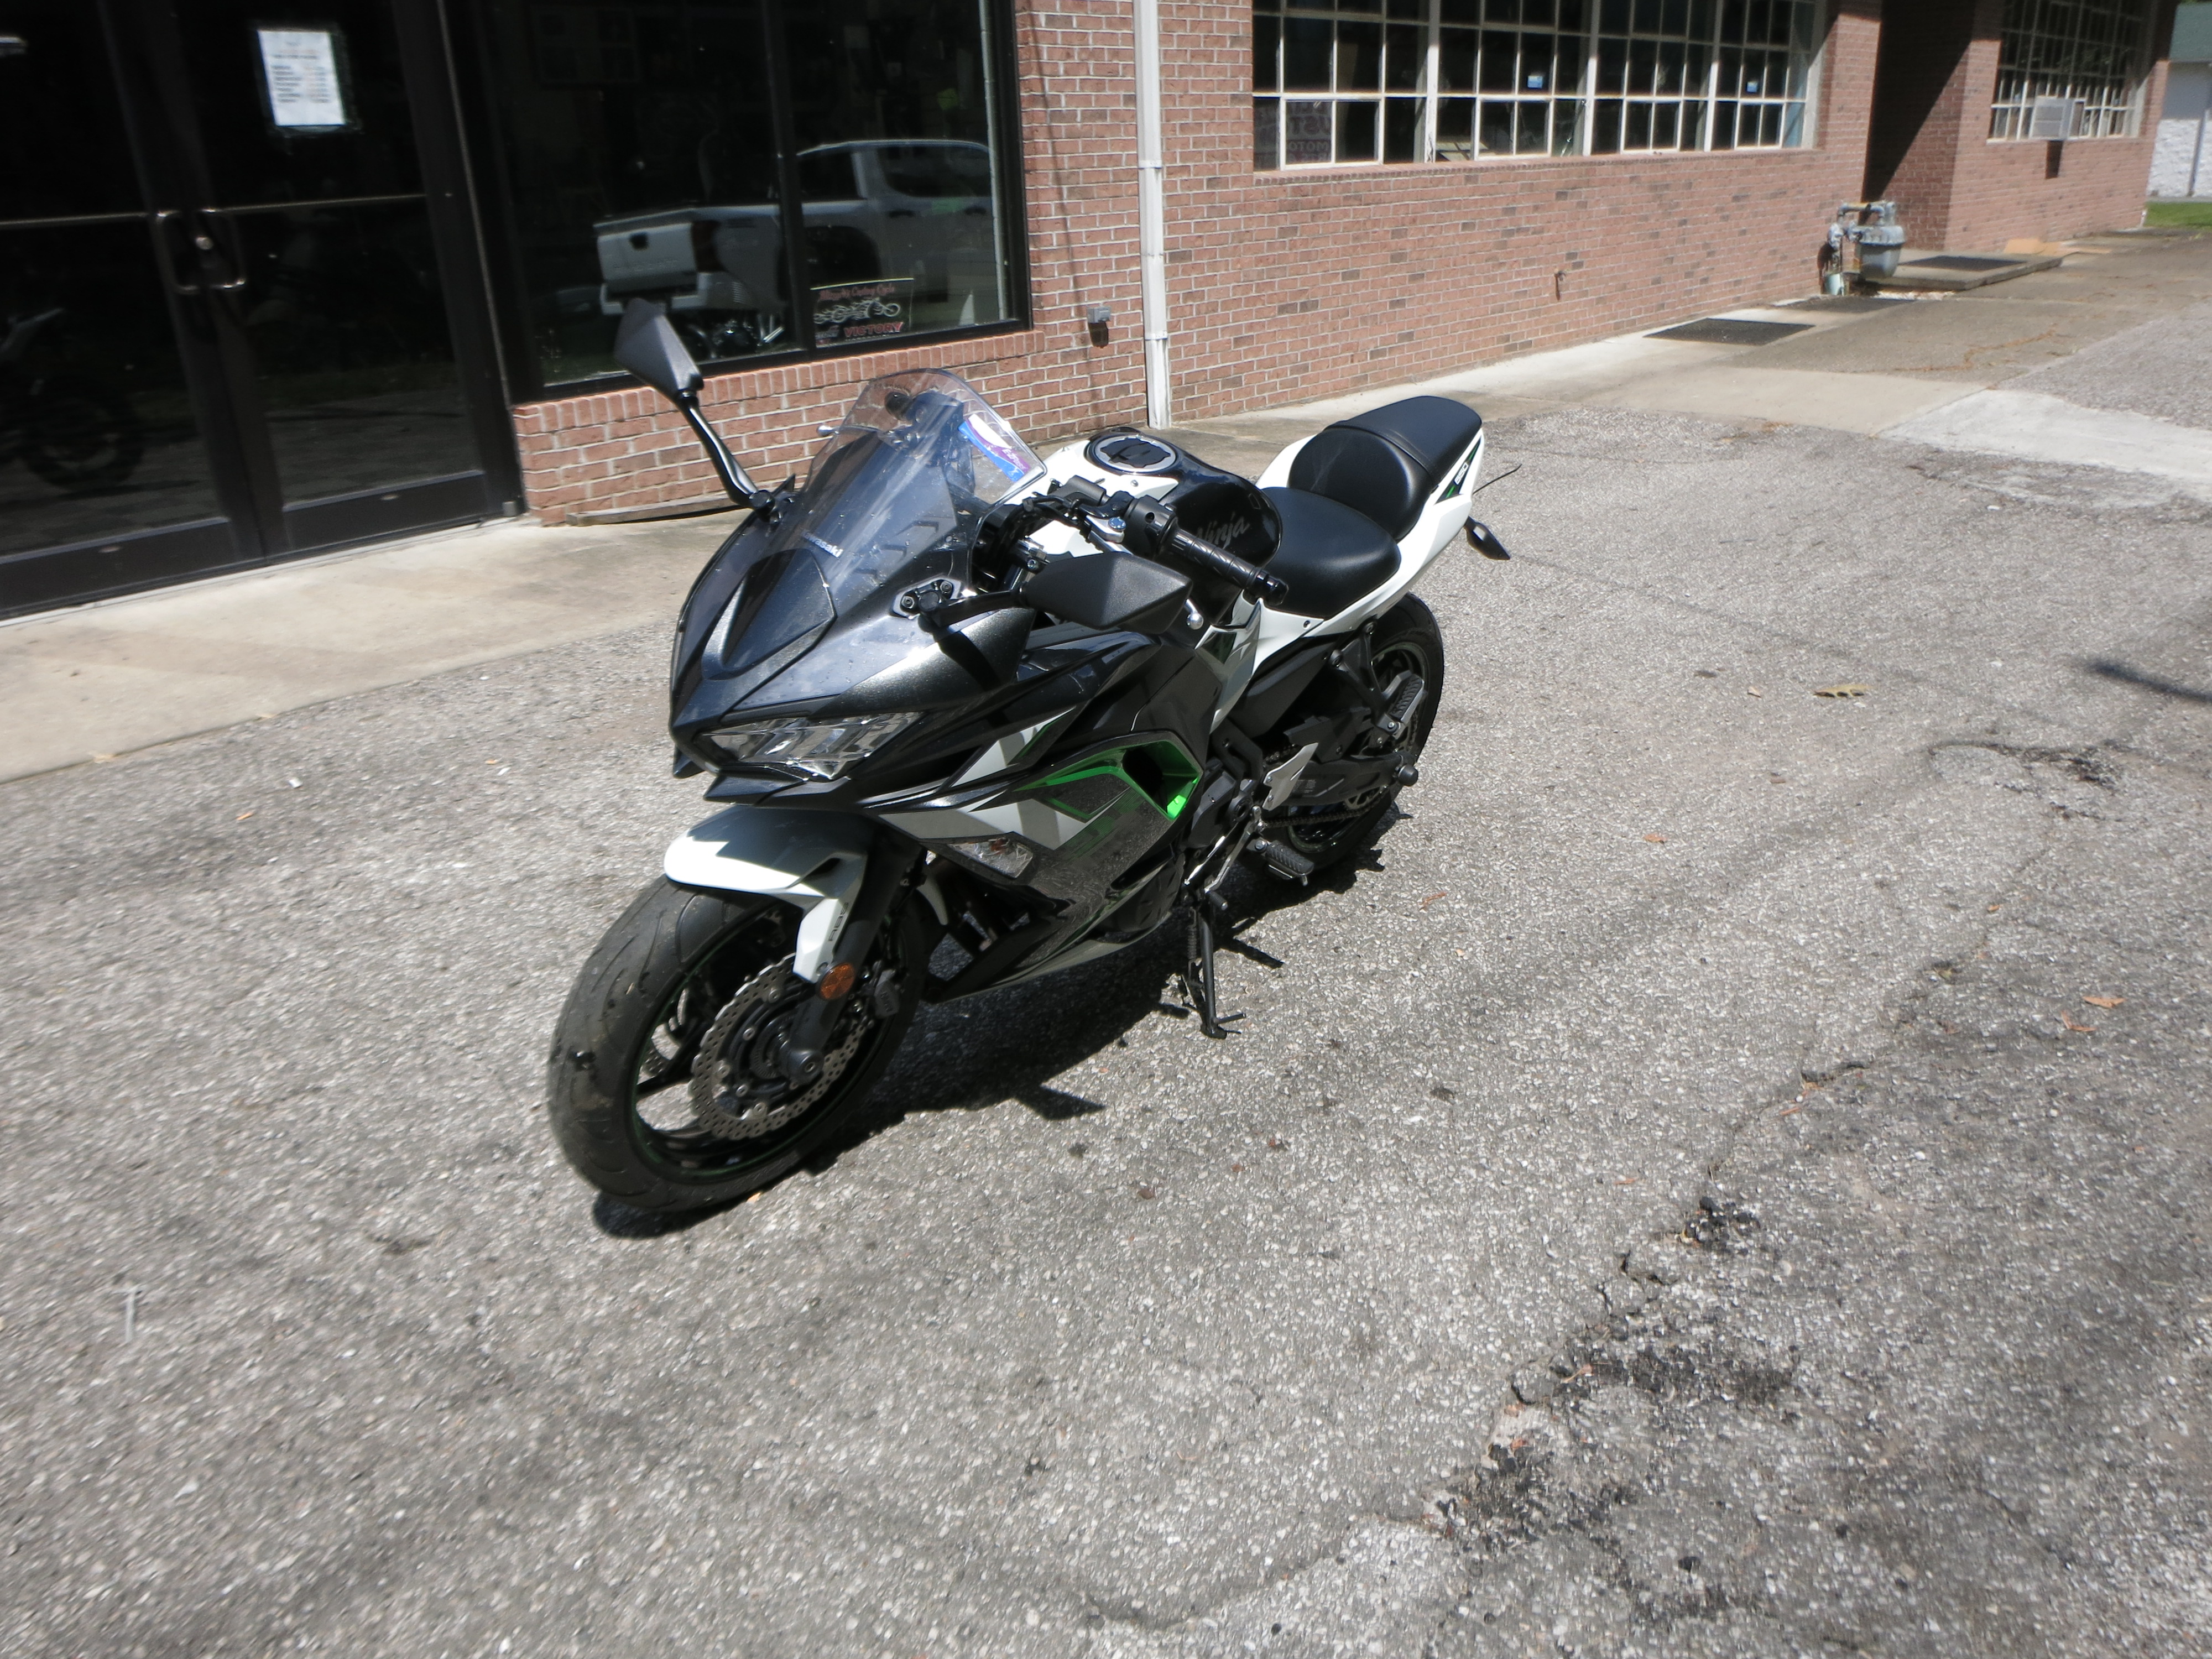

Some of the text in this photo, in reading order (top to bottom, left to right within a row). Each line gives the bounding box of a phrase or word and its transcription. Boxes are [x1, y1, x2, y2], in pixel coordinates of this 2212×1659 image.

[845, 321, 904, 337] VICTORY
[1455, 463, 1469, 484] 650
[1197, 511, 1250, 550] Ninja
[829, 902, 849, 941] ABS
